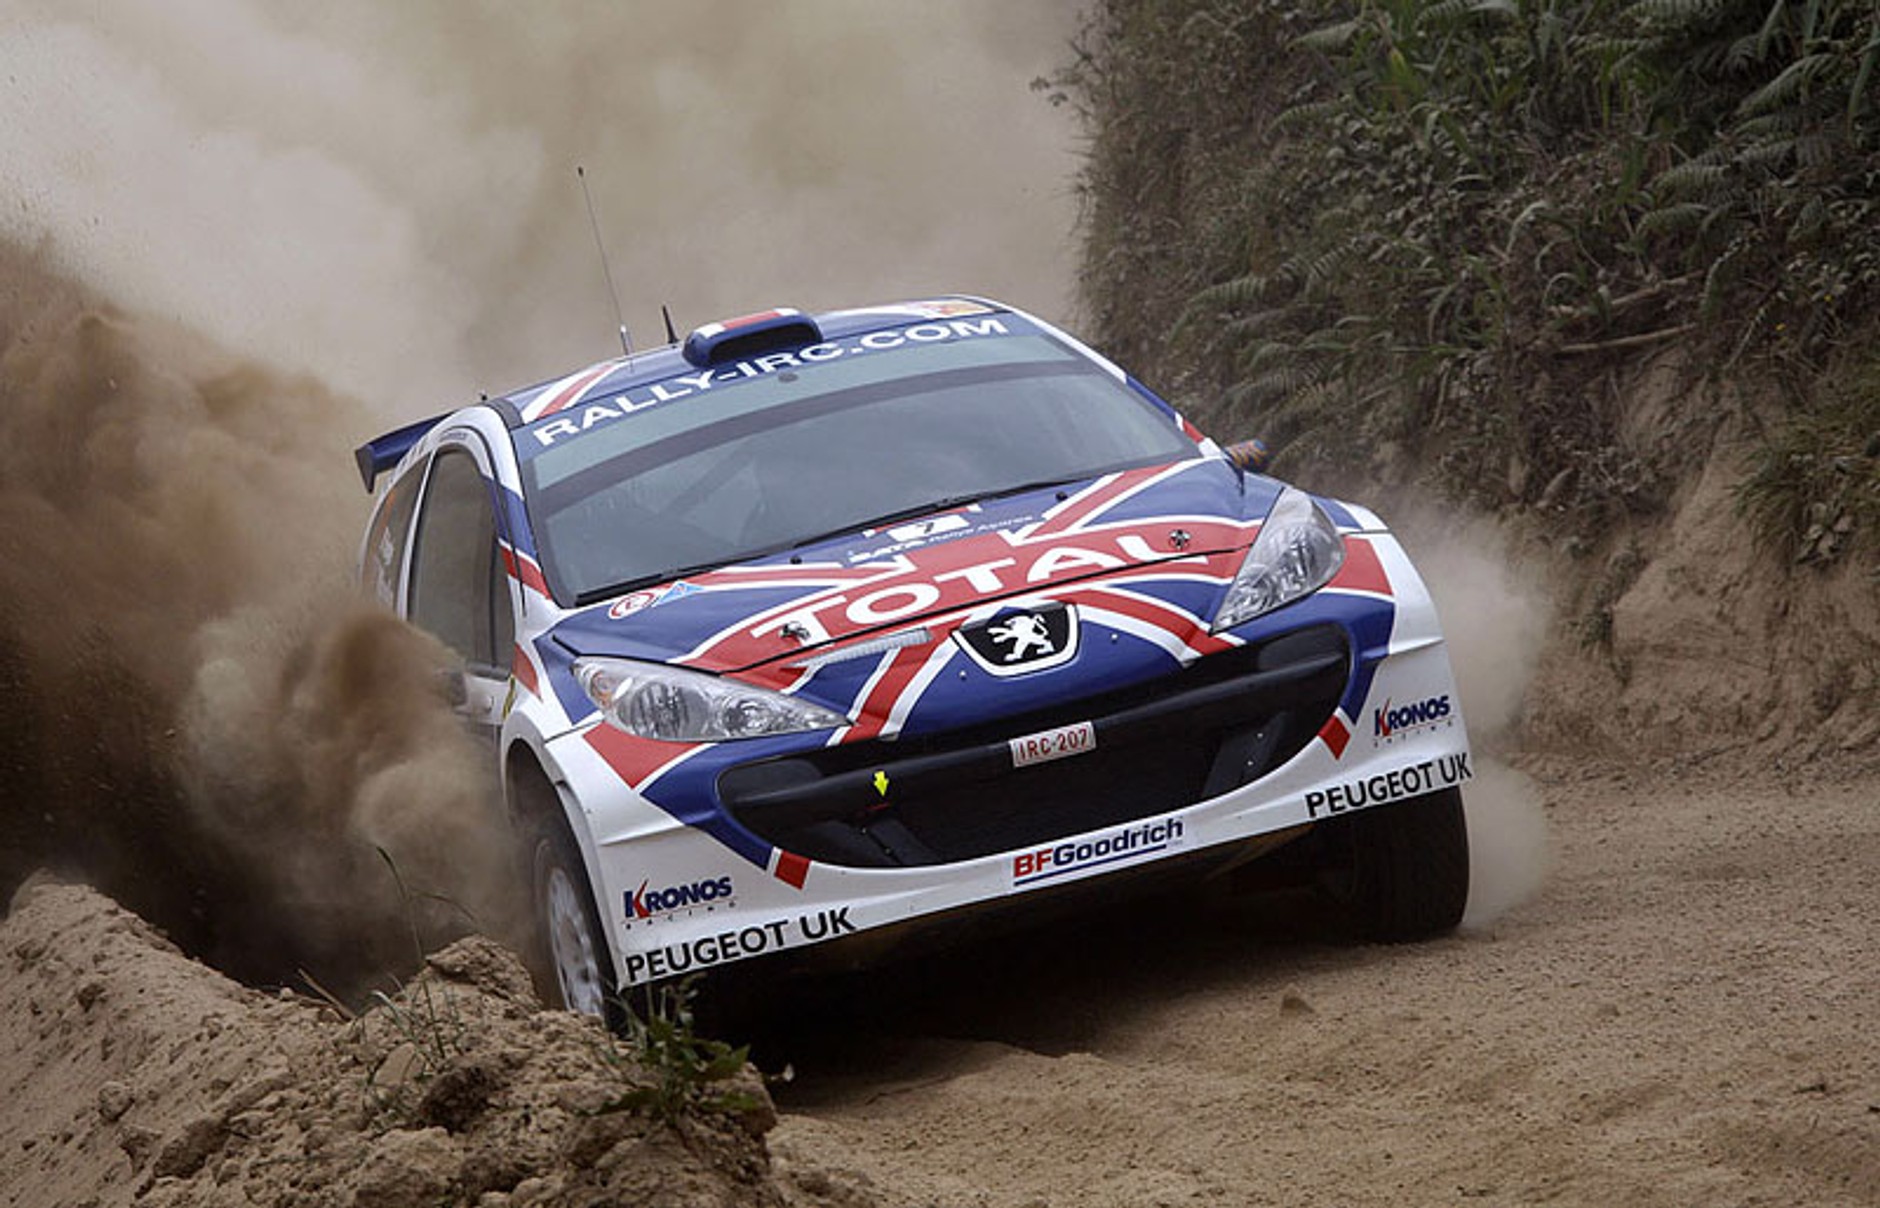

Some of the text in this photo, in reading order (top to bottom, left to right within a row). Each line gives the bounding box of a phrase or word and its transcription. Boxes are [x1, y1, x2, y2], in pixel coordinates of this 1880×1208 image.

[533, 317, 1009, 447] RALLY-IRC.COM
[750, 535, 1209, 650] TOTAL
[1019, 728, 1088, 761] IRC-207
[1375, 696, 1451, 737] KRONOS
[1305, 752, 1472, 818] PEUGEOT UK
[1013, 818, 1183, 878] BFGoodrich
[623, 876, 733, 919] KRONOS
[625, 906, 856, 982] PEUGEOT UK
